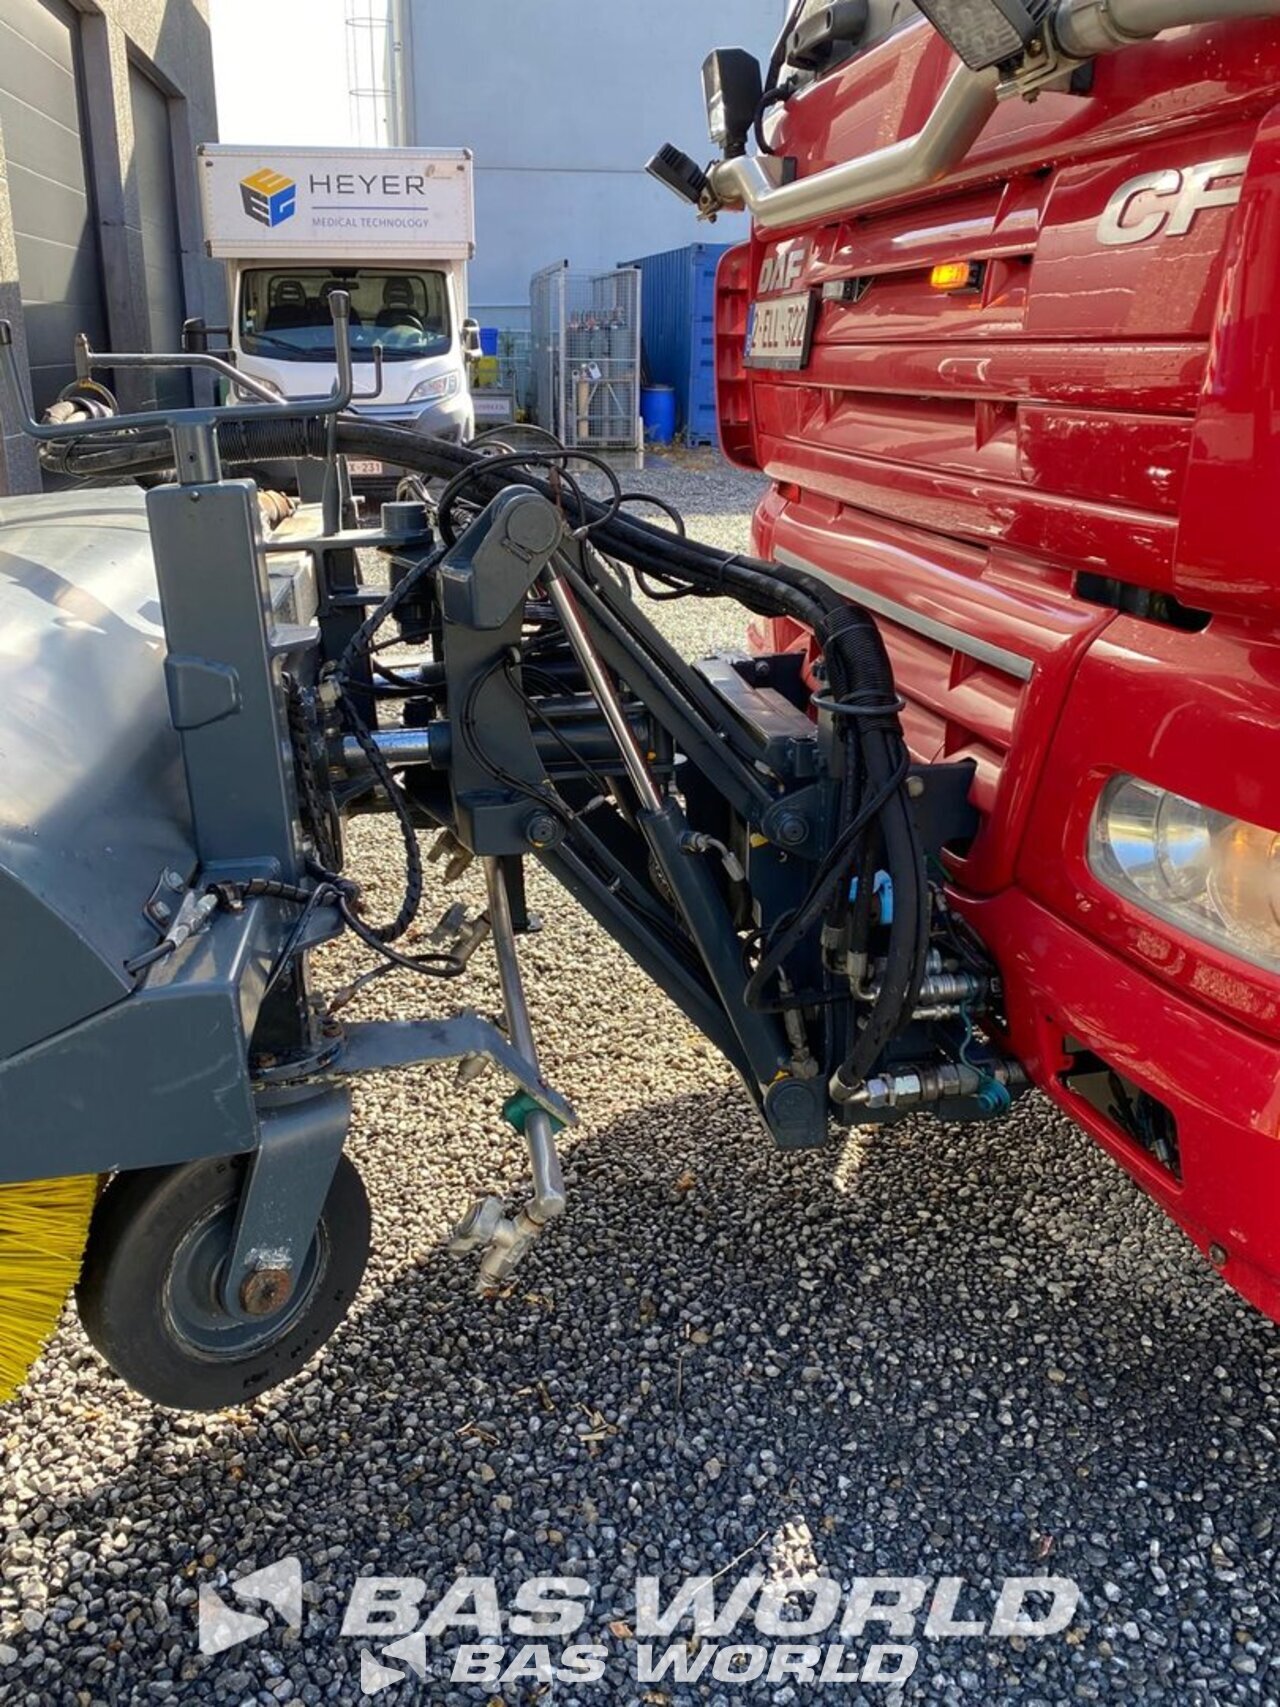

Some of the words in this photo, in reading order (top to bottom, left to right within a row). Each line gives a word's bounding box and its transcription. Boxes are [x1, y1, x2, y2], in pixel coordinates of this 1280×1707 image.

[309, 174, 426, 195] HEYER
[1096, 155, 1250, 245] CF
[312, 217, 358, 228] MEDICAL
[361, 217, 429, 229] TECHNOLOGY
[758, 248, 806, 293] DAF
